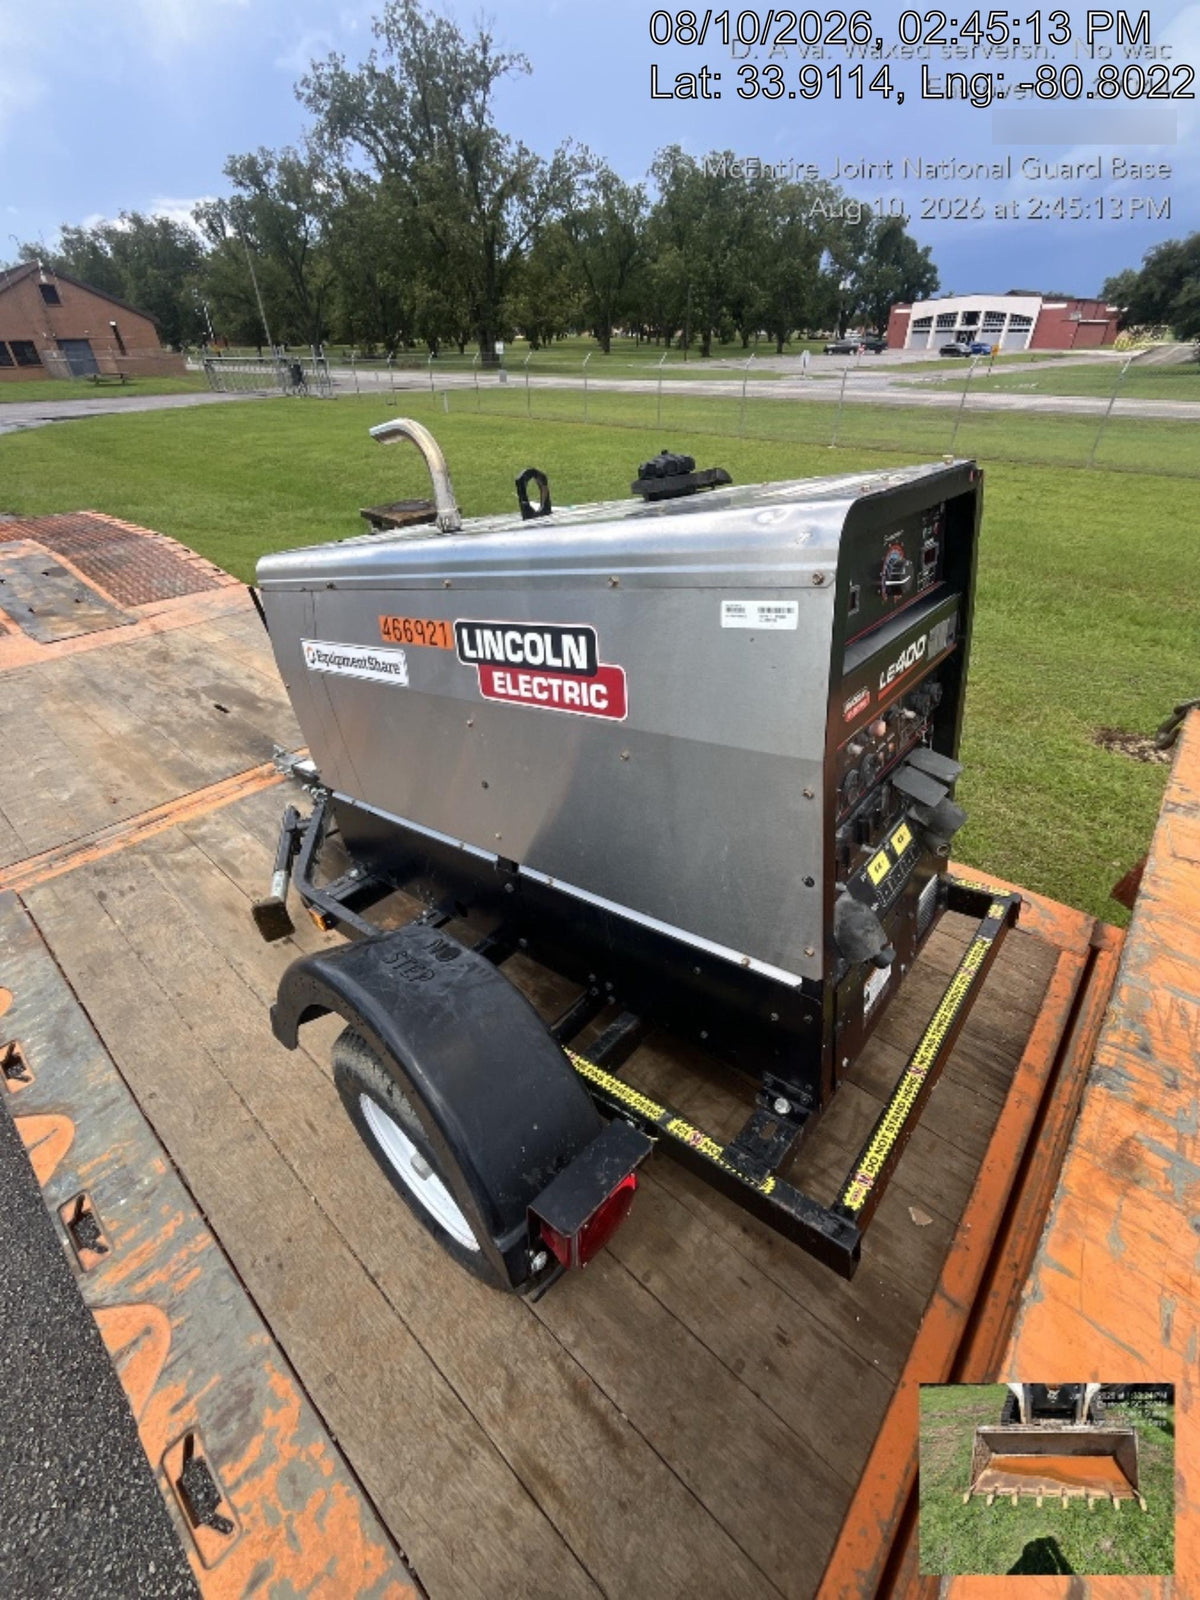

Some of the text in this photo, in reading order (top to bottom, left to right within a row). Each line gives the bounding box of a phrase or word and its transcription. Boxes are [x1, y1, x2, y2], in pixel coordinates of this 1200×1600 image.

[382, 617, 449, 648] 466921
[315, 649, 401, 675] EquipmentShare
[461, 627, 589, 670] LINCOLN
[492, 670, 609, 700] ELECTRIC
[865, 1156, 880, 1173] DO
[876, 1134, 890, 1156] NOT
